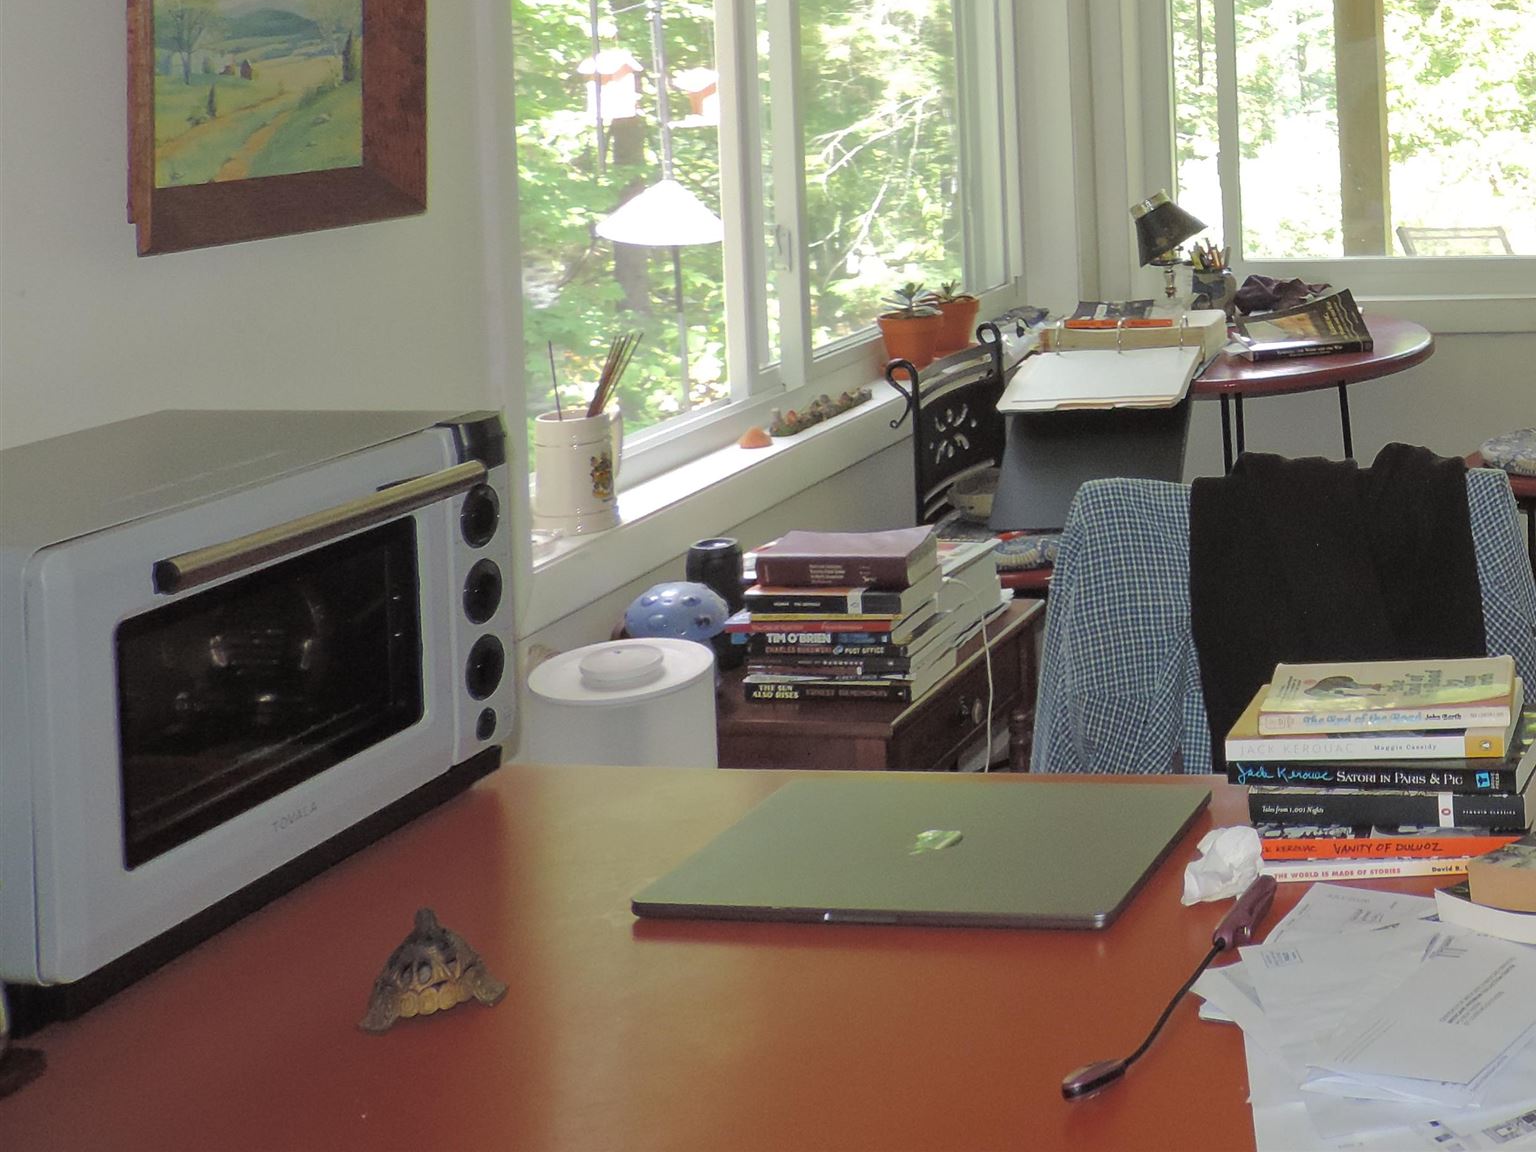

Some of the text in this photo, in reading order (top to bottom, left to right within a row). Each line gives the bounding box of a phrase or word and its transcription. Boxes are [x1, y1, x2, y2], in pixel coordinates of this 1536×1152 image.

[766, 633, 787, 643] TIM
[787, 632, 831, 643] O'BRIEN
[862, 646, 885, 654] OFFICE
[752, 691, 799, 699] ALSO RISES
[1240, 743, 1353, 755] JACK KEROUAC
[1374, 743, 1437, 752] Maggie Cassidy
[1236, 762, 1335, 784] Jack Kerouac
[1336, 771, 1377, 784] SATORI
[1380, 773, 1391, 784] IN
[1394, 772, 1426, 785] PARIS
[1429, 773, 1441, 785] &
[1275, 806, 1289, 815] from
[1333, 842, 1443, 855] VANITY OF DULUOZ
[1431, 865, 1453, 873] David
